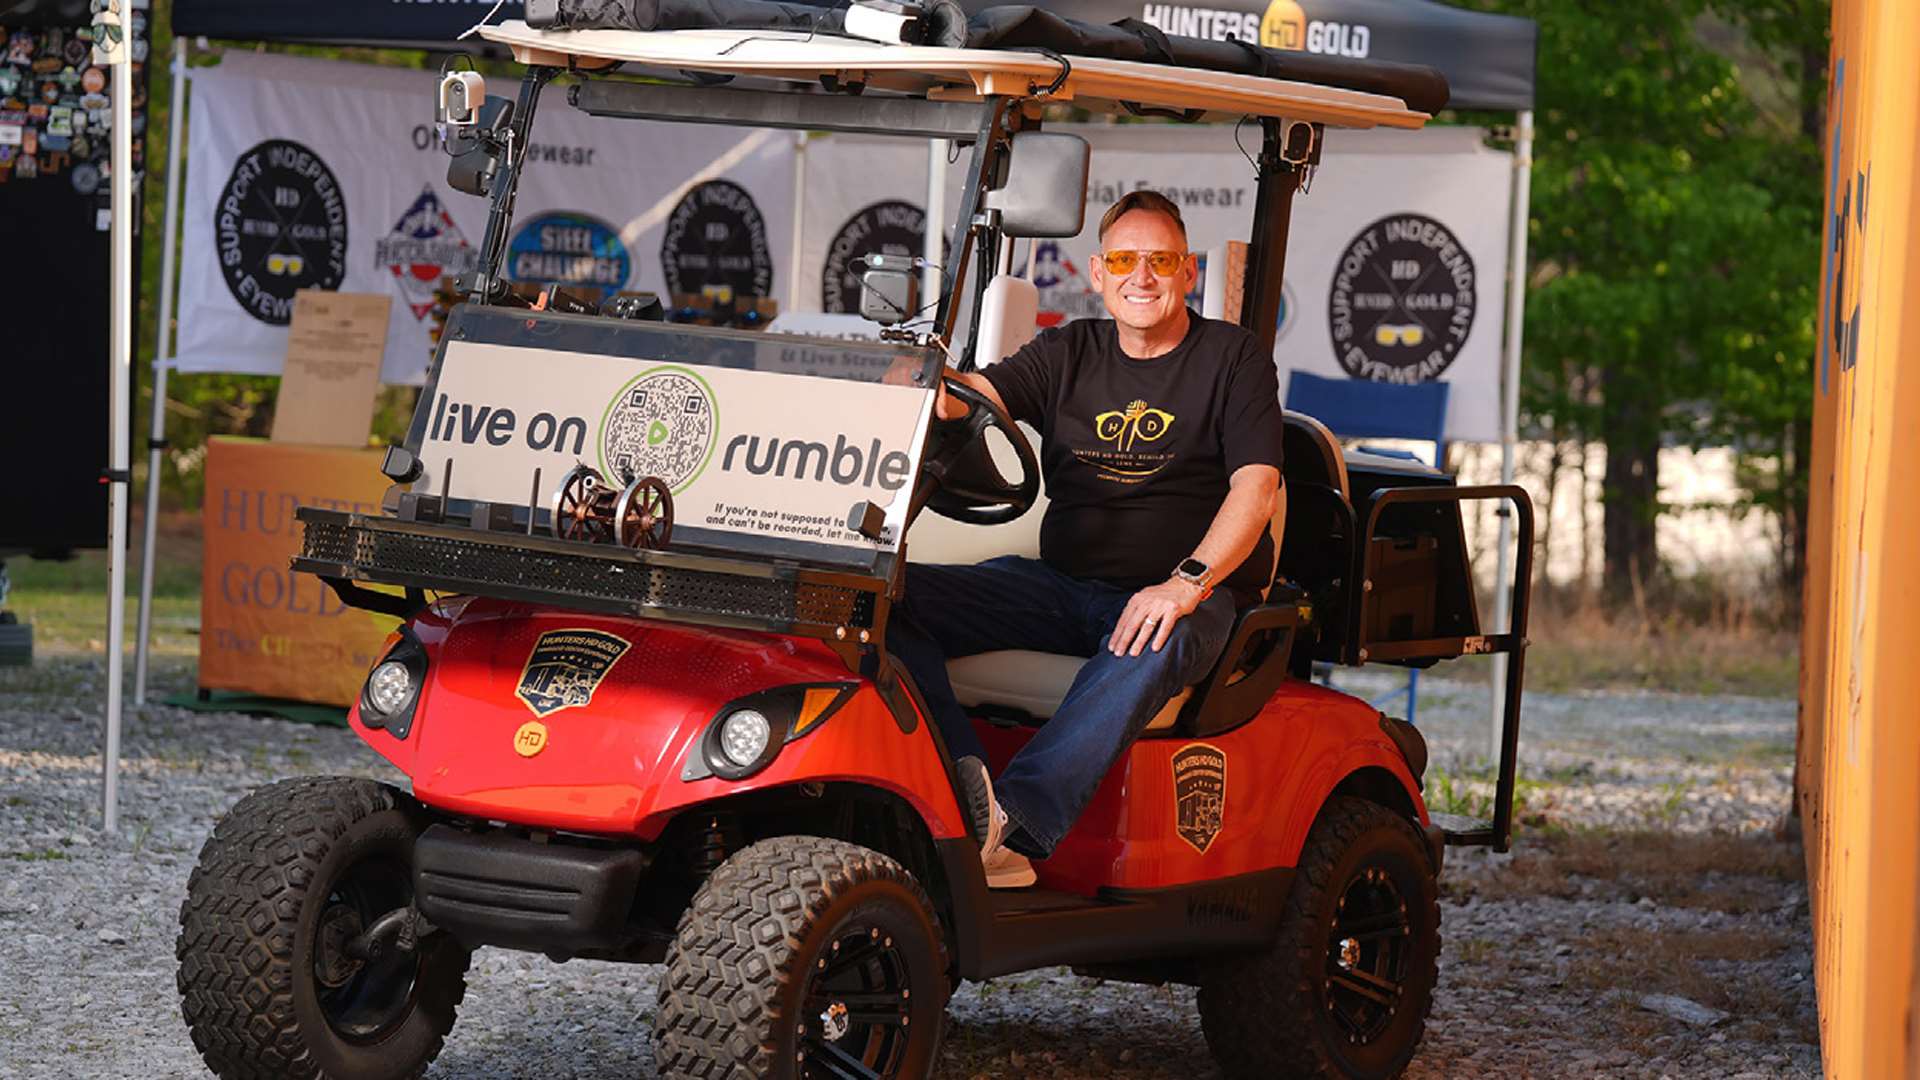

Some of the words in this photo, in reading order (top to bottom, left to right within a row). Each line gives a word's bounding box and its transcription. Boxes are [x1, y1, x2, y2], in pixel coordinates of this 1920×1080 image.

[1143, 4, 1260, 45] HUNTERS
[1269, 18, 1299, 47] HD
[1307, 20, 1370, 58] GOLD
[527, 143, 595, 166] ewear
[1134, 180, 1246, 207] Eewear
[220, 153, 262, 267] SUPPORT
[268, 146, 345, 276] INDEPENDENT
[1333, 229, 1380, 342] SUPPORT
[1385, 218, 1473, 343] INDEPENDENT
[1344, 346, 1446, 386] EYEWEAR
[1107, 423, 1118, 432] H
[1147, 420, 1157, 431] D
[430, 393, 516, 446] live
[525, 411, 588, 456] on
[721, 433, 910, 492] rumble
[705, 513, 726, 525] and
[727, 515, 755, 529] can't
[757, 519, 771, 531] be
[773, 521, 825, 538] recorded,
[826, 527, 842, 540] let
[844, 532, 861, 542] me
[714, 503, 724, 514] If
[725, 505, 758, 519] you're
[760, 509, 779, 520] not
[780, 512, 831, 527] supposed
[833, 516, 845, 528] to
[542, 635, 586, 647] HUNTERS
[598, 640, 622, 656] GOLD
[518, 730, 542, 747] HD
